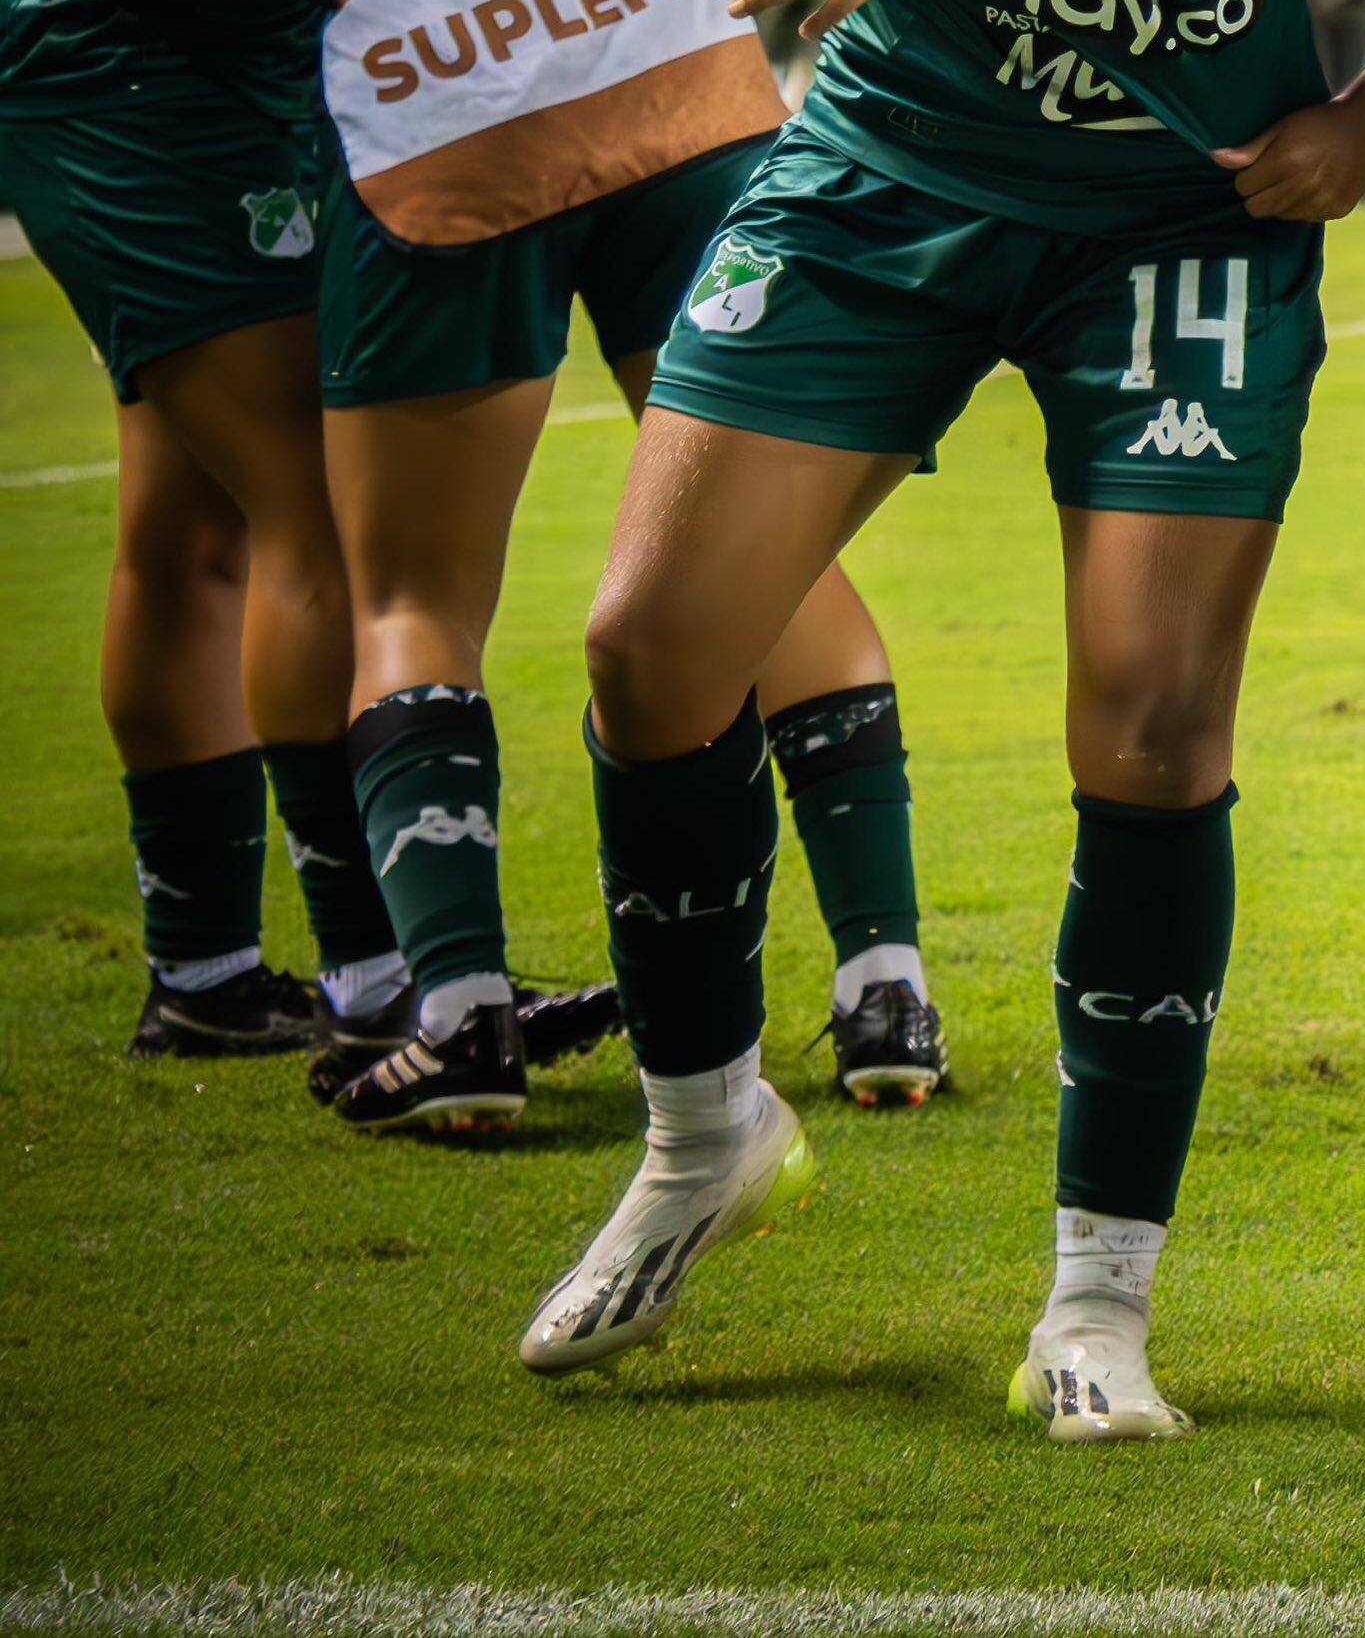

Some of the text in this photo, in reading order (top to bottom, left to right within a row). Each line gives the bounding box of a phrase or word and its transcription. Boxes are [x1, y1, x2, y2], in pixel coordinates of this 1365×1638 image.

[1119, 259, 1248, 390] 14
[612, 876, 751, 923] ALI
[1078, 990, 1217, 1025] CAL
